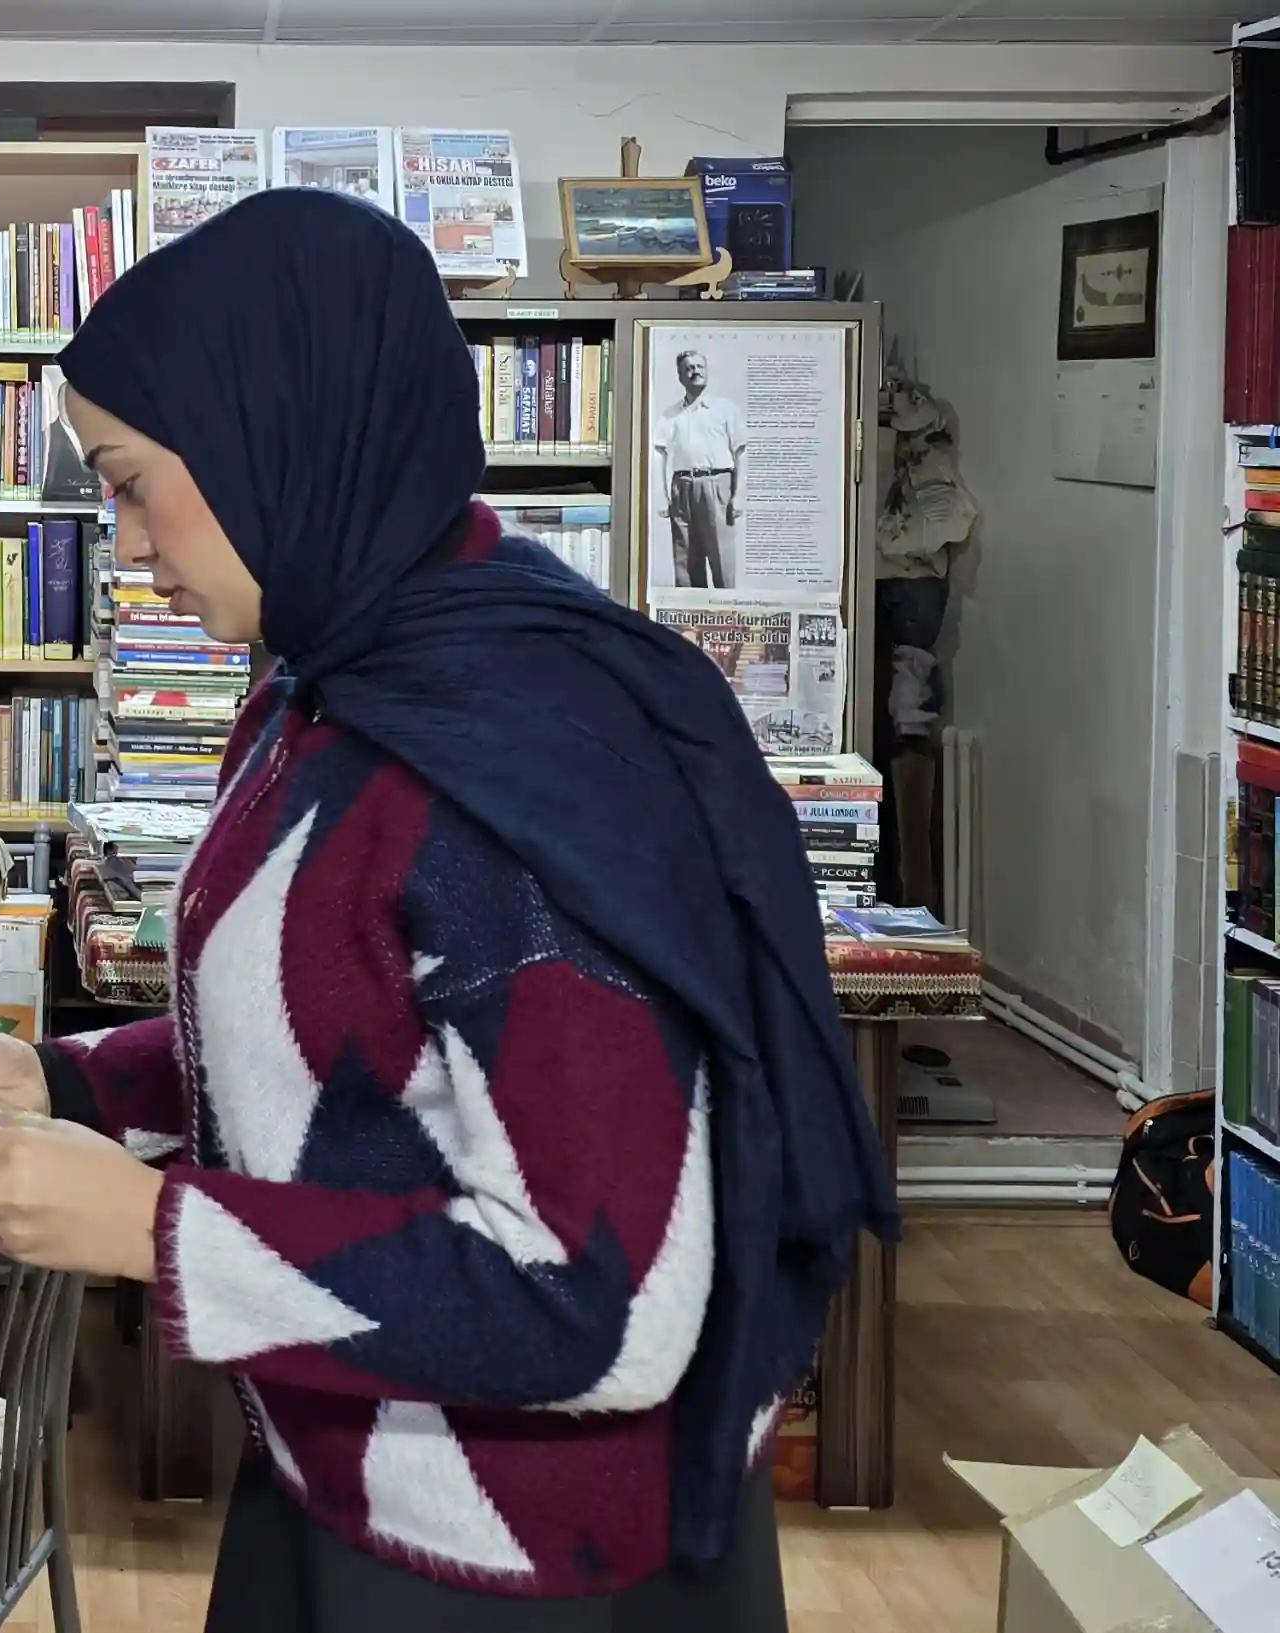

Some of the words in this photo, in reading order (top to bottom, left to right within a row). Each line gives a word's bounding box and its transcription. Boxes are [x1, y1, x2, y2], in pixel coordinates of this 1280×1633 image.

[167, 158, 221, 171] ZAFER
[436, 175, 460, 185] OKULA
[705, 174, 737, 187] beko
[737, 611, 789, 627] kurmak
[703, 631, 755, 644] sevdası
[760, 630, 789, 644] oldu
[810, 807, 829, 817] JULIA
[831, 807, 859, 818] LONDON
[836, 868, 857, 878] CAST
